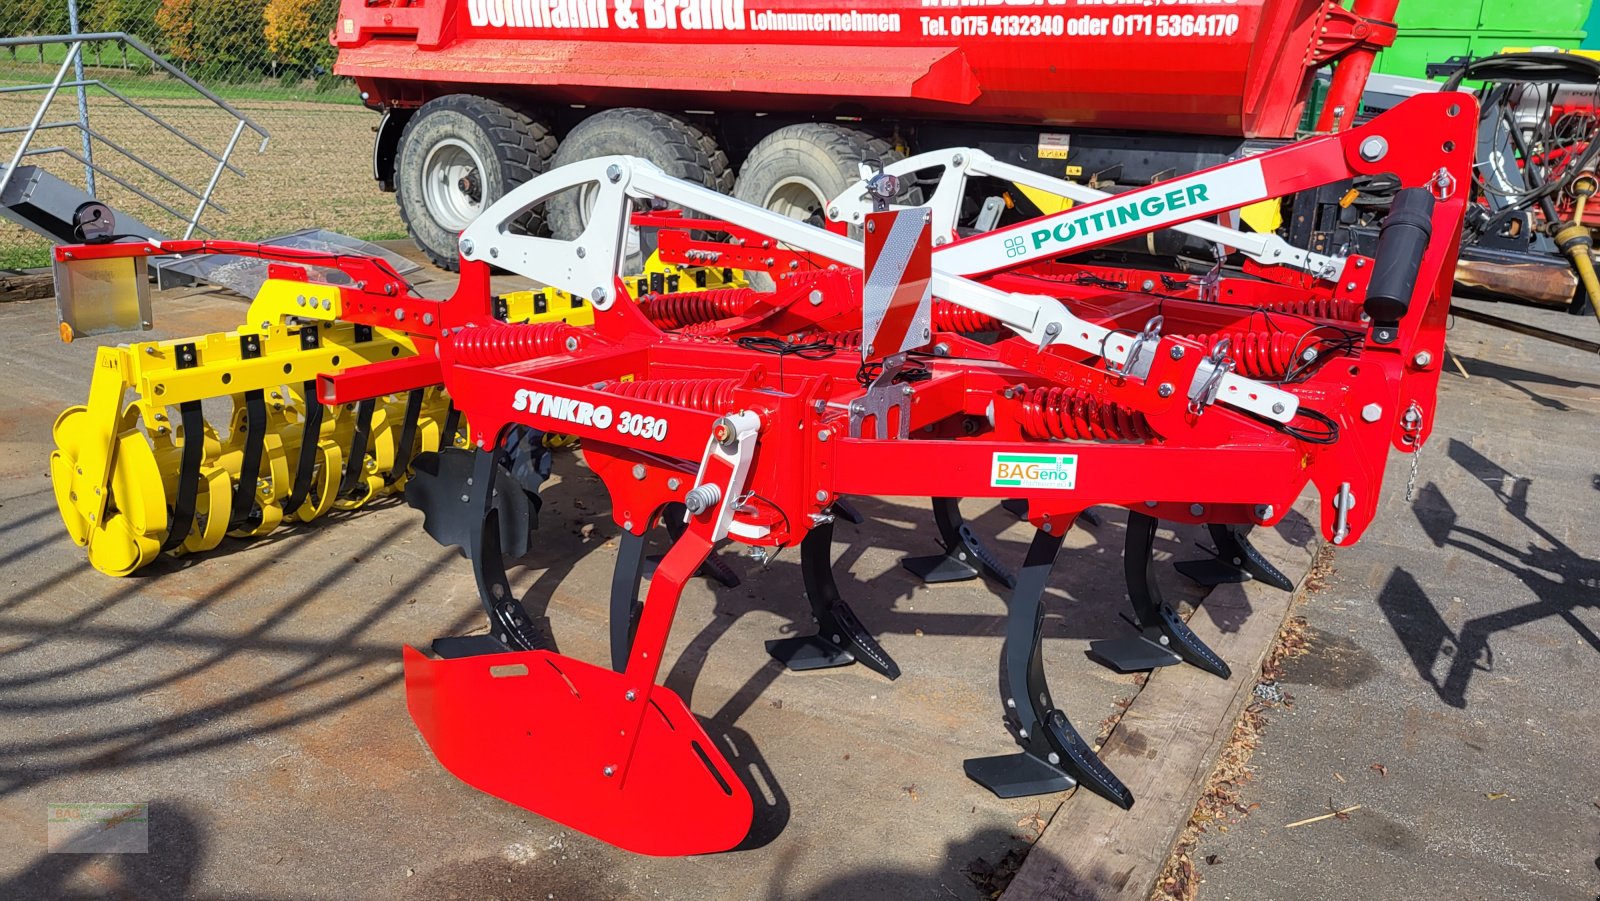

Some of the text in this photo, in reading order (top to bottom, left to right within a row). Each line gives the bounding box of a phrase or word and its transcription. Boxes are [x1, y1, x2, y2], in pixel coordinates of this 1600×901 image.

[614, 0, 639, 29] &
[644, 0, 746, 30] Brand
[750, 10, 901, 32] Lohnunternehmen
[920, 14, 1239, 36] Tel. 0175 4132340 oder 0171 5364170
[1031, 183, 1210, 249] PÖTTINGER
[512, 388, 668, 442] SYNKRO 3030
[997, 463, 1068, 481] BAGeno
